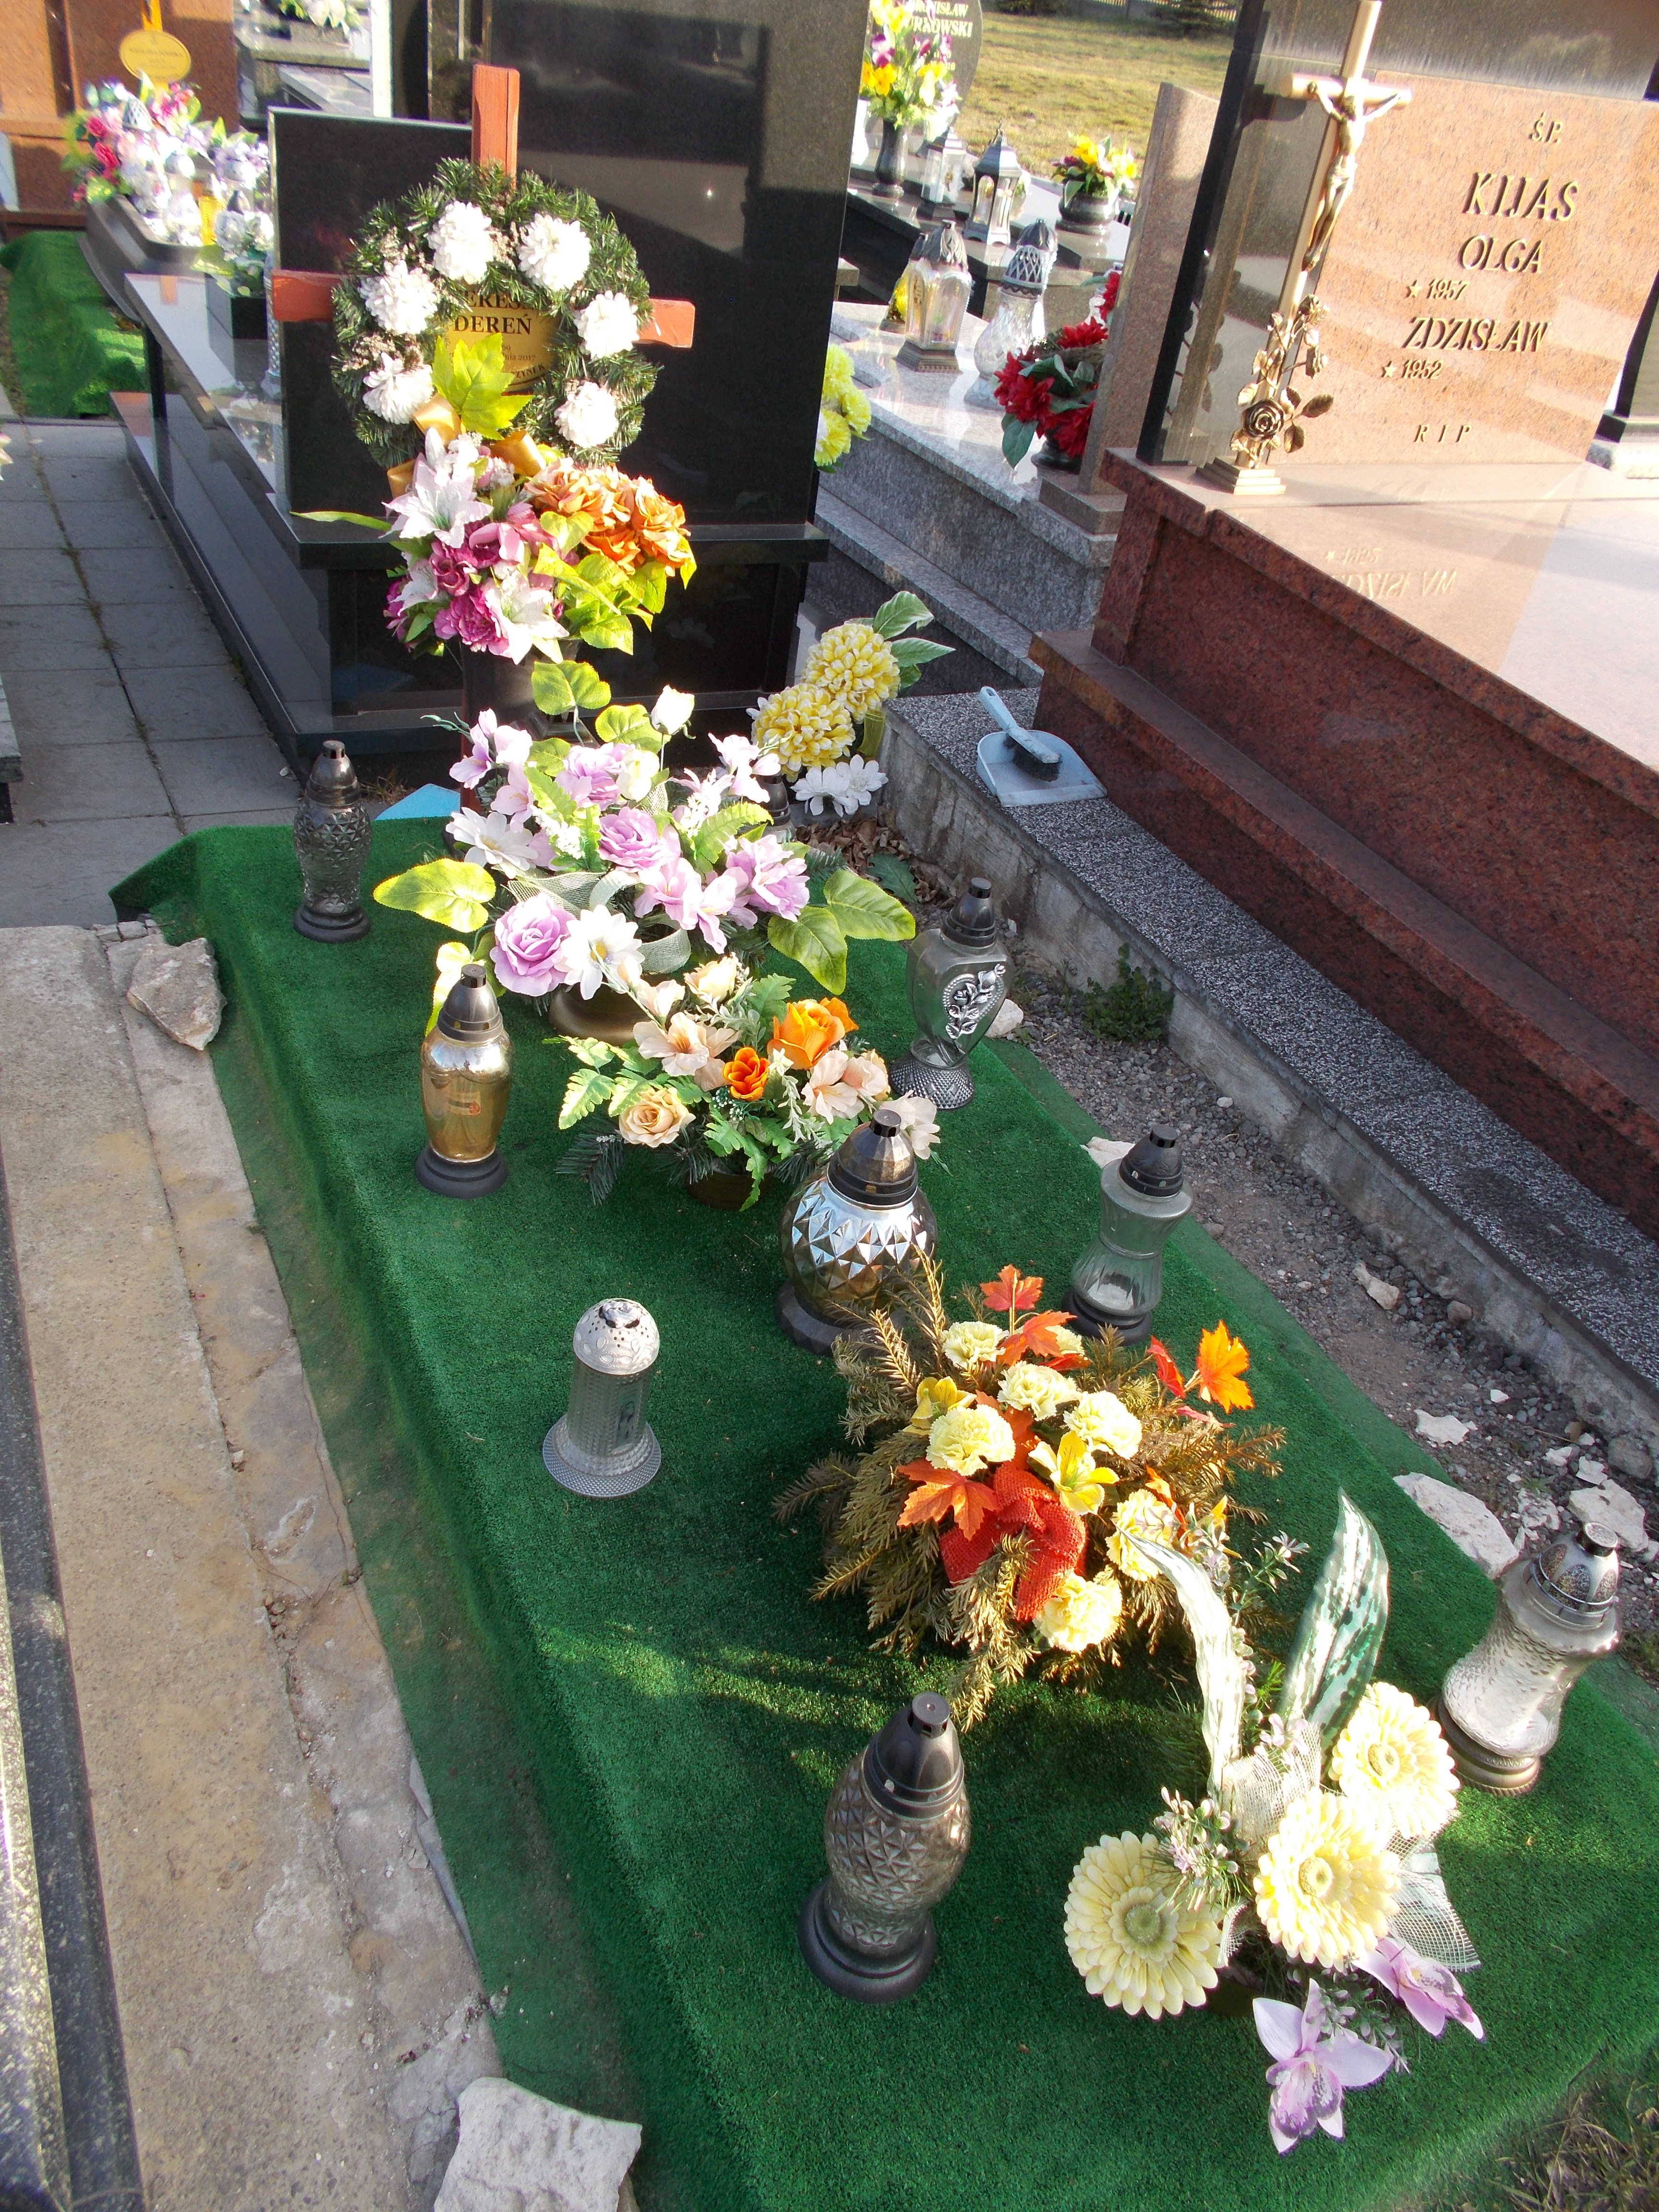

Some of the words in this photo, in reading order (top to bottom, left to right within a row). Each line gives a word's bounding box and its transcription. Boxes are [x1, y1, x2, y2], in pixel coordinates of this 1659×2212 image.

[1461, 171, 1580, 221] KIJAS
[1457, 234, 1544, 274] OLGA
[1426, 278, 1470, 301] 1957
[454, 313, 532, 335] DEREŃ
[1401, 317, 1552, 352] ZDZISŁAW
[518, 354, 536, 362] 2017
[1401, 359, 1443, 380] 1952
[1414, 424, 1430, 443] R
[1455, 424, 1472, 443] P
